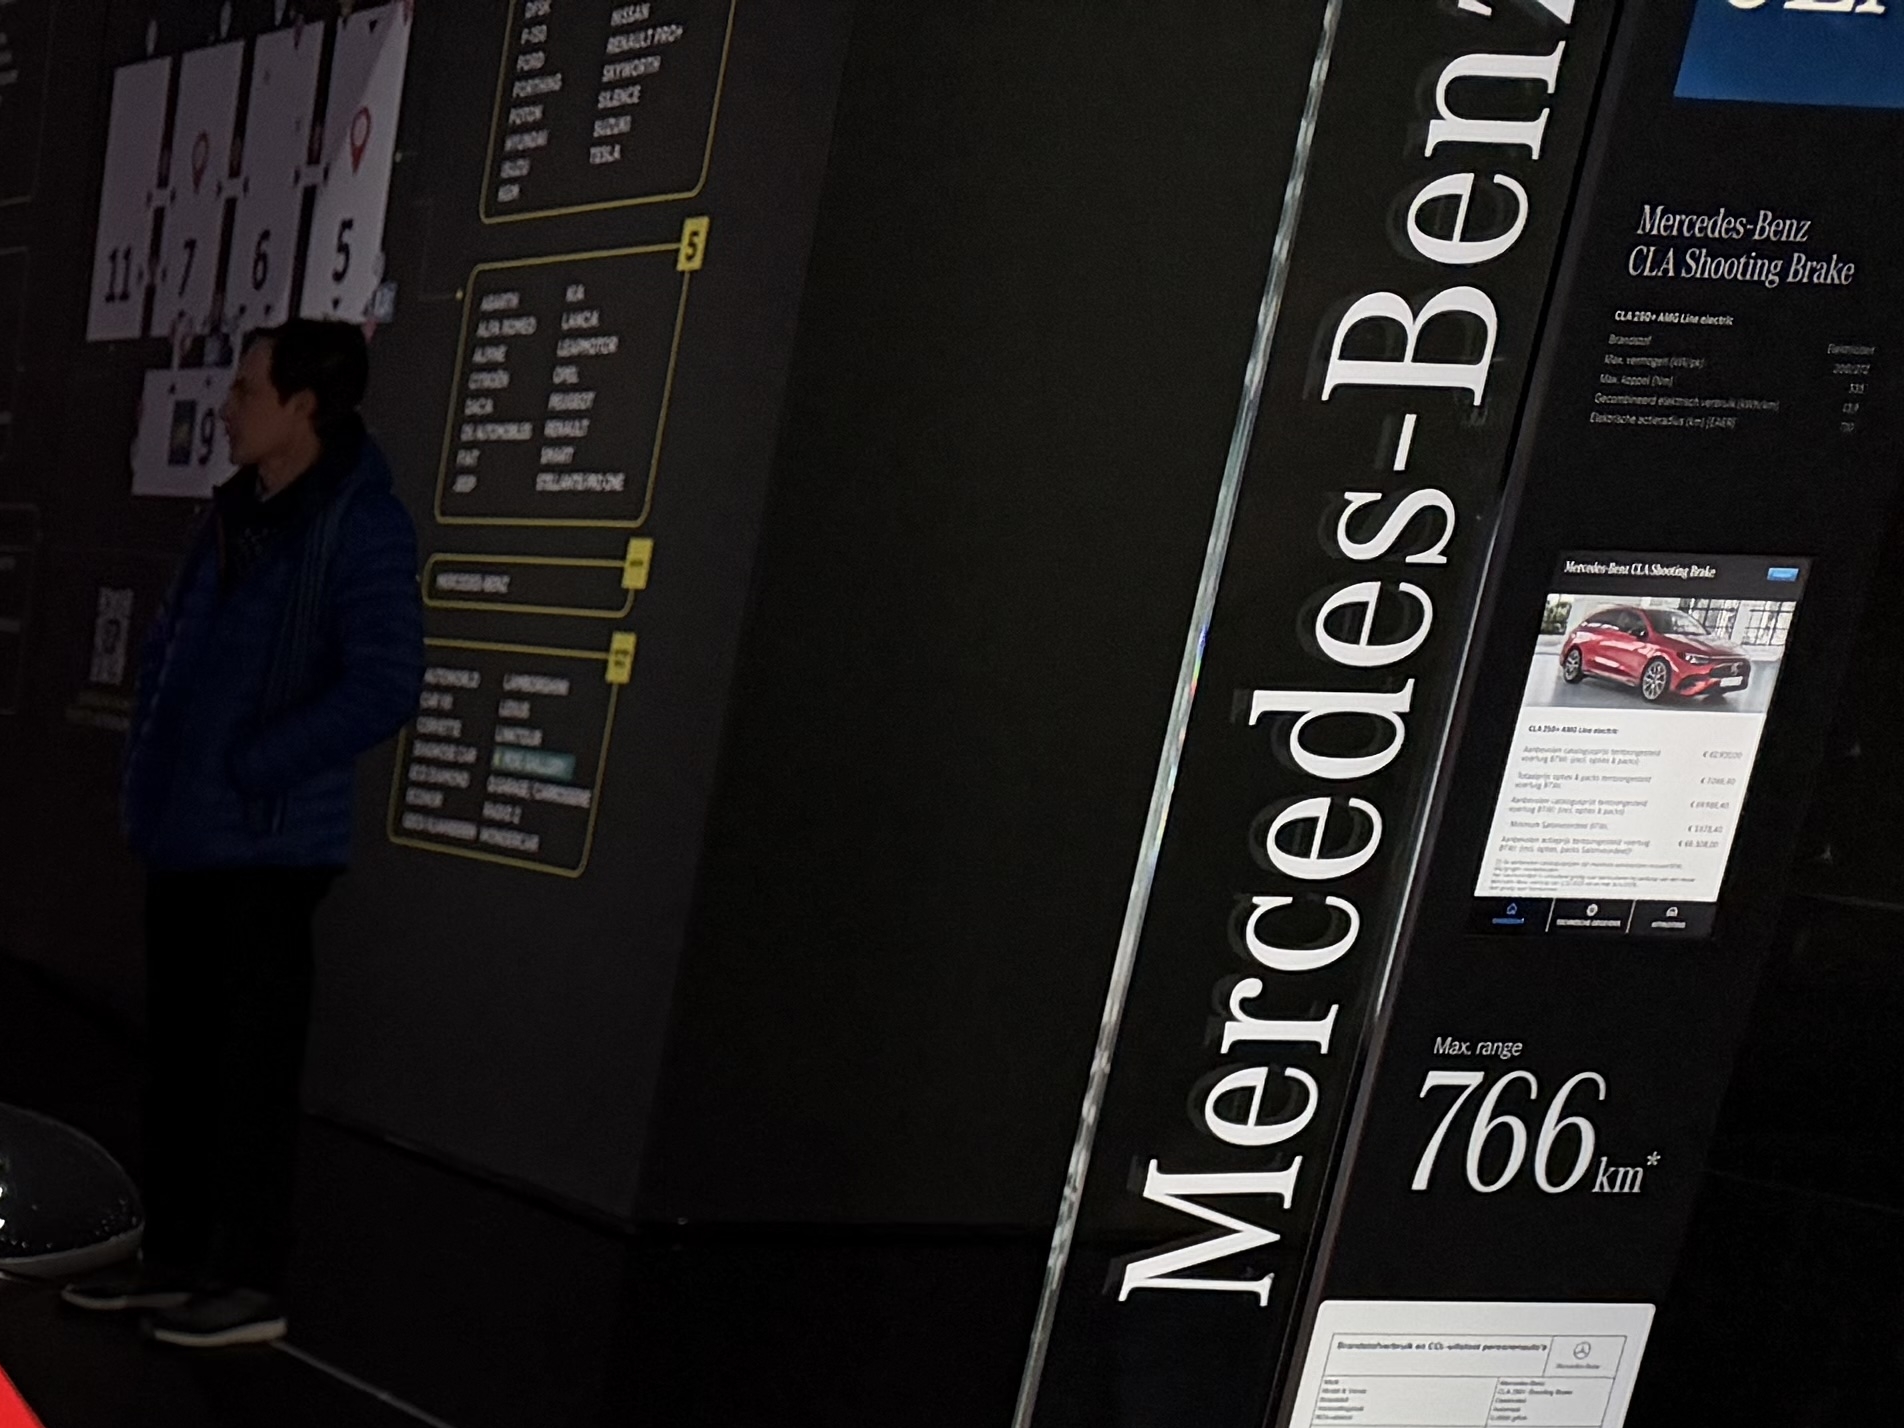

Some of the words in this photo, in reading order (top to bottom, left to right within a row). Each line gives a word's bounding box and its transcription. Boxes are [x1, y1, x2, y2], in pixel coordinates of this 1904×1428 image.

[333, 218, 353, 283] 5
[685, 230, 699, 260] 5
[1636, 204, 1812, 243] Mercedes-Benz
[104, 245, 131, 304] 11
[180, 238, 196, 297] 7
[251, 229, 271, 290] 6
[1628, 245, 1675, 278] CLA
[1681, 247, 1784, 289] Shooting
[1785, 251, 1856, 286] Brake
[1614, 310, 1633, 322] CLA
[1679, 313, 1699, 325] Line
[1699, 315, 1734, 326] electric
[199, 407, 215, 466] 9
[1118, 0, 1578, 1303] Mercedes-Ben
[1433, 1036, 1471, 1057] Max.
[1475, 1039, 1523, 1059] range
[1410, 1069, 1606, 1194] 766
